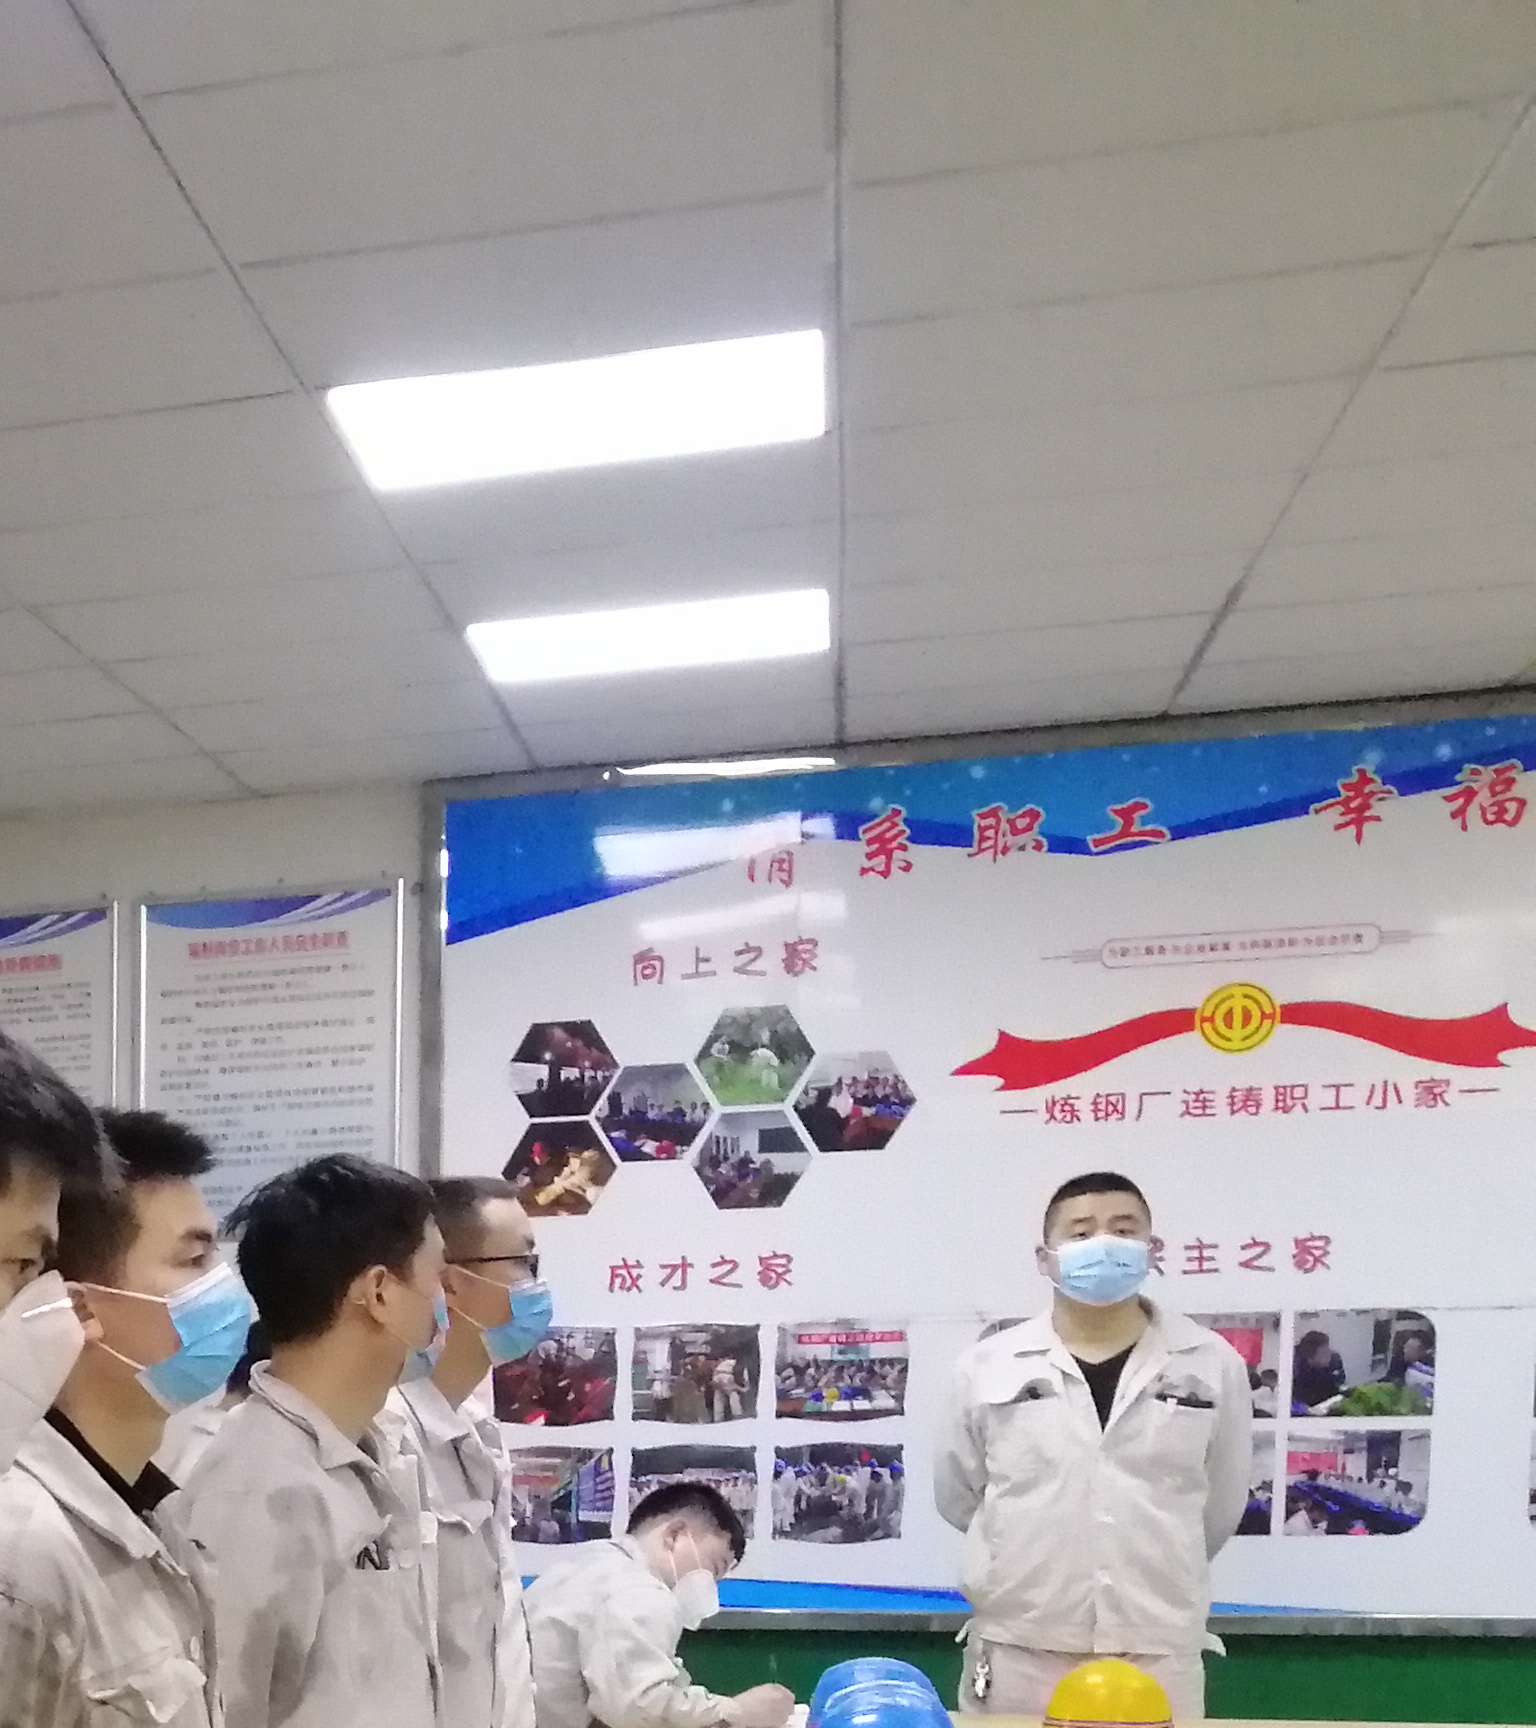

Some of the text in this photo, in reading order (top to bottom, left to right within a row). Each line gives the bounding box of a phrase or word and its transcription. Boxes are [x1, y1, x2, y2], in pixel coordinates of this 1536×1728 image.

[1312, 764, 1527, 845] 幸福
[632, 935, 818, 986] 向上之家
[608, 1251, 794, 1293] 成才之家
